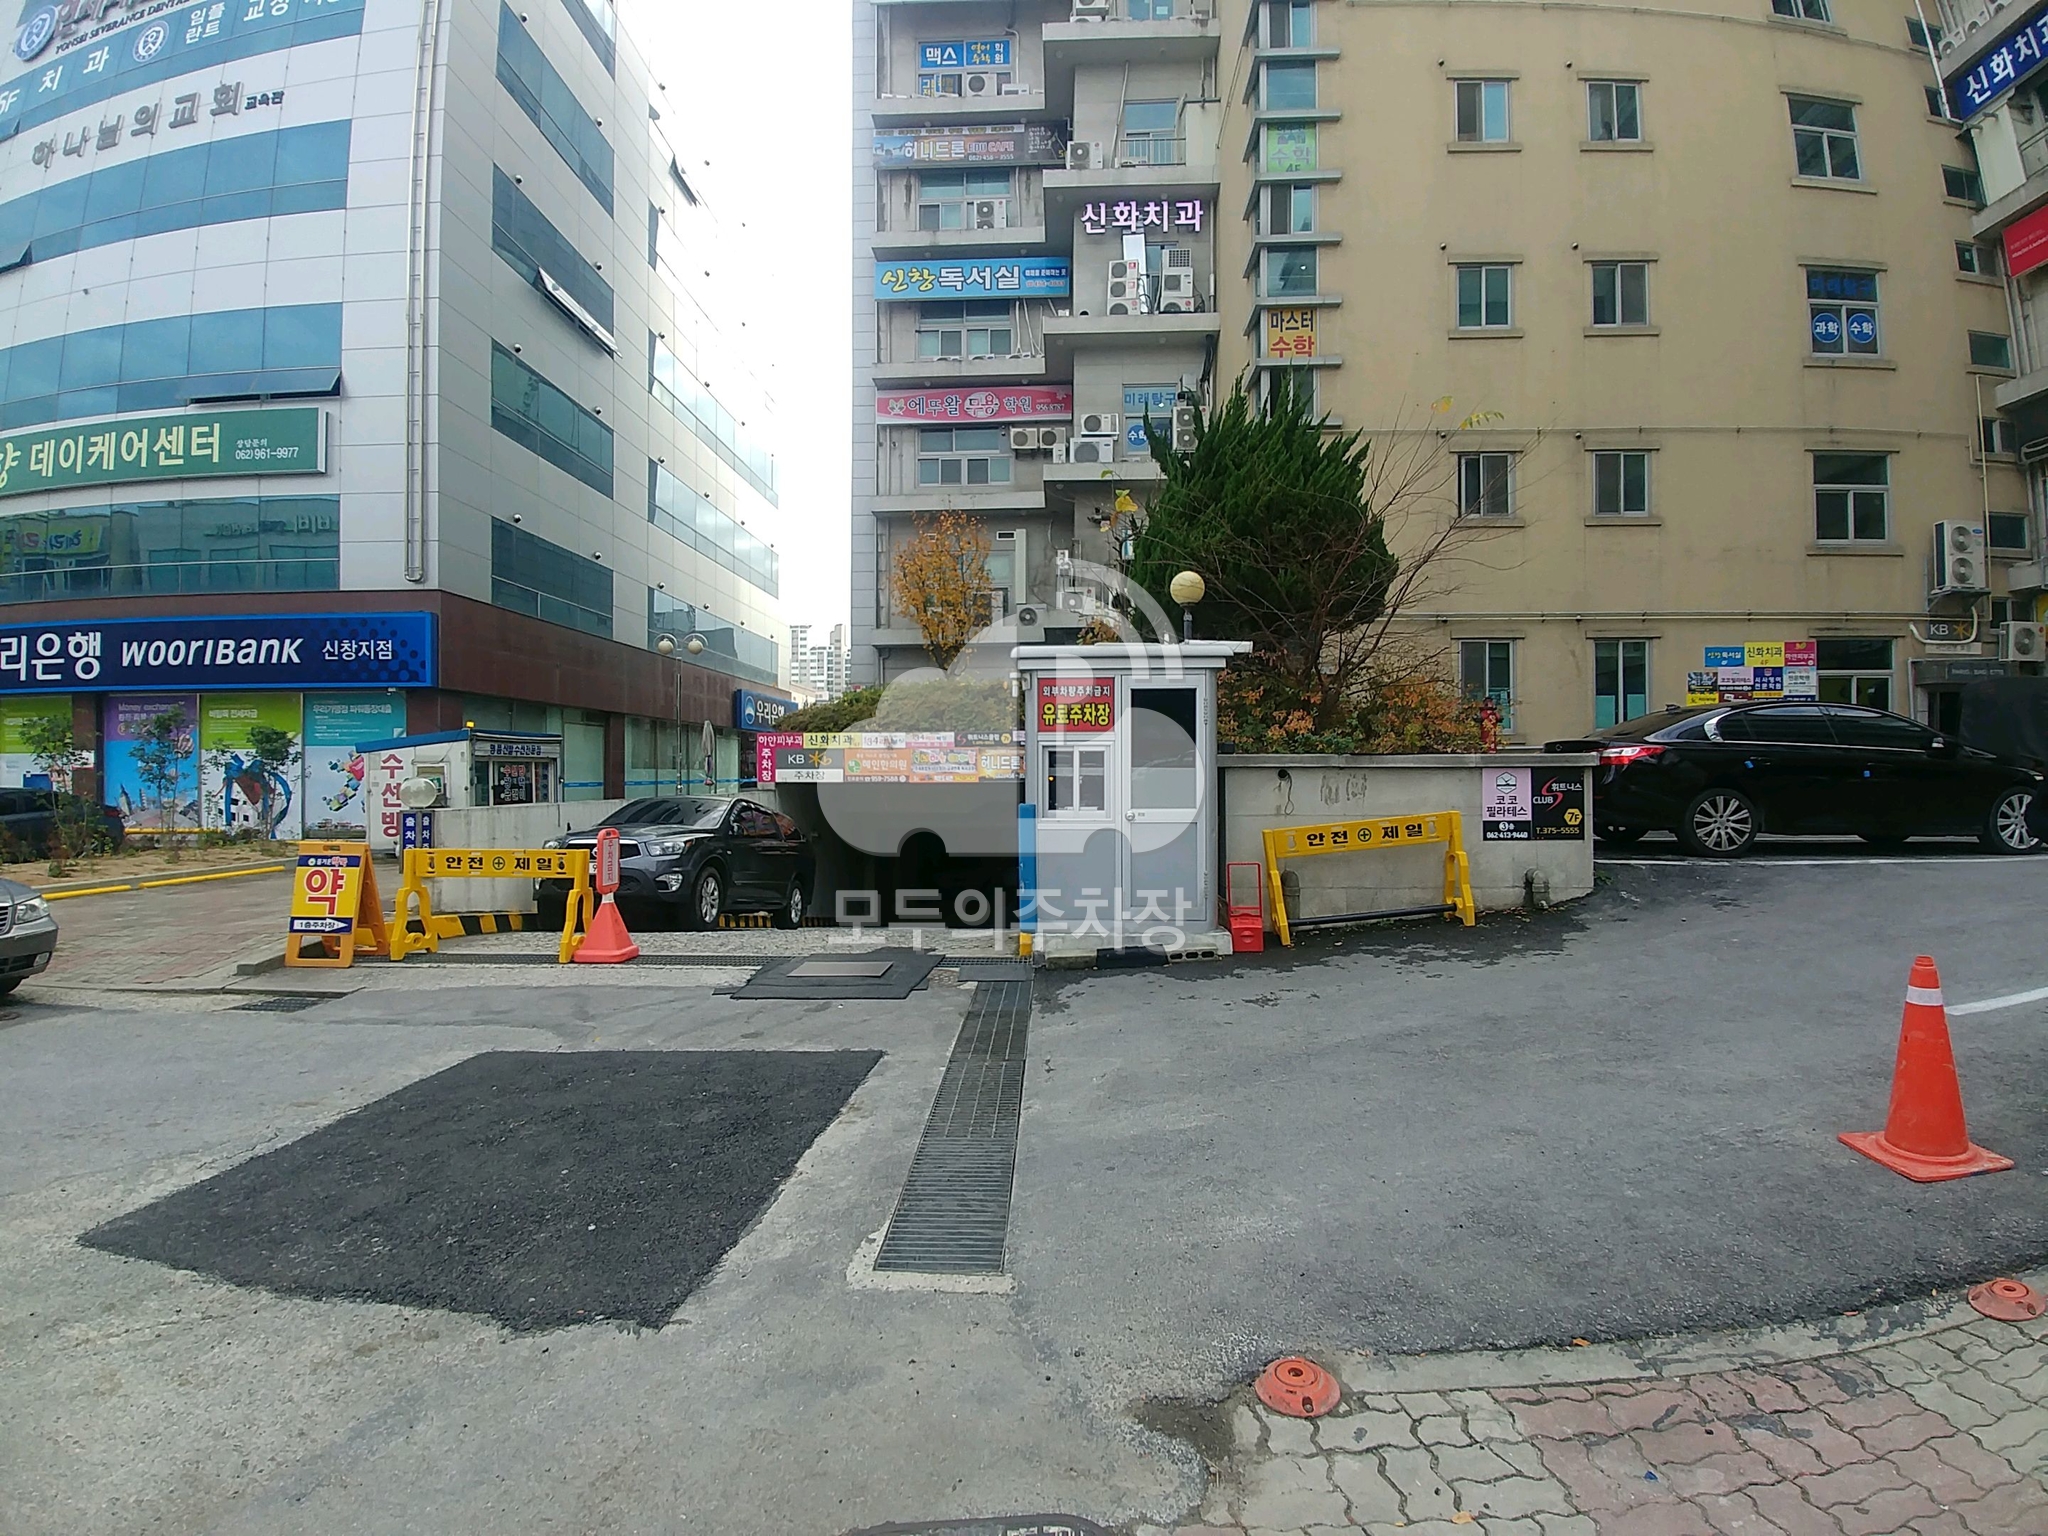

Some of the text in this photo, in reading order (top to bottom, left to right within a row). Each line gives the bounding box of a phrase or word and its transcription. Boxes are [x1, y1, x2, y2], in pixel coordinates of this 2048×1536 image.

[925, 46, 958, 65] 맥스
[1080, 199, 1204, 235] 신화치과
[1270, 309, 1314, 333] 마스터
[1815, 321, 1839, 335] 과학
[1850, 321, 1874, 335] 수학
[1270, 335, 1315, 359] 수학
[1002, 396, 1032, 413] 학원
[1124, 392, 1176, 406] 미래탐구
[29, 422, 221, 478] 데이케어센터
[1930, 623, 1949, 635] KB
[321, 639, 393, 661] 신창지점
[1747, 647, 1782, 658] 신화치과
[1042, 702, 1111, 726] 유료주차장
[808, 734, 853, 746] 신화치과
[761, 748, 773, 781] 주차장
[787, 755, 805, 764] KB
[793, 770, 826, 780] 주차장
[1551, 782, 1583, 791] 휘트니스
[1495, 795, 1519, 805] 코코
[1532, 796, 1554, 804] CLUB
[1486, 806, 1528, 817] 필라테스
[1567, 811, 1581, 823] 7F
[1305, 823, 1423, 847] 안전 제일
[445, 856, 553, 870] 안전 제일
[305, 868, 346, 916] 약
